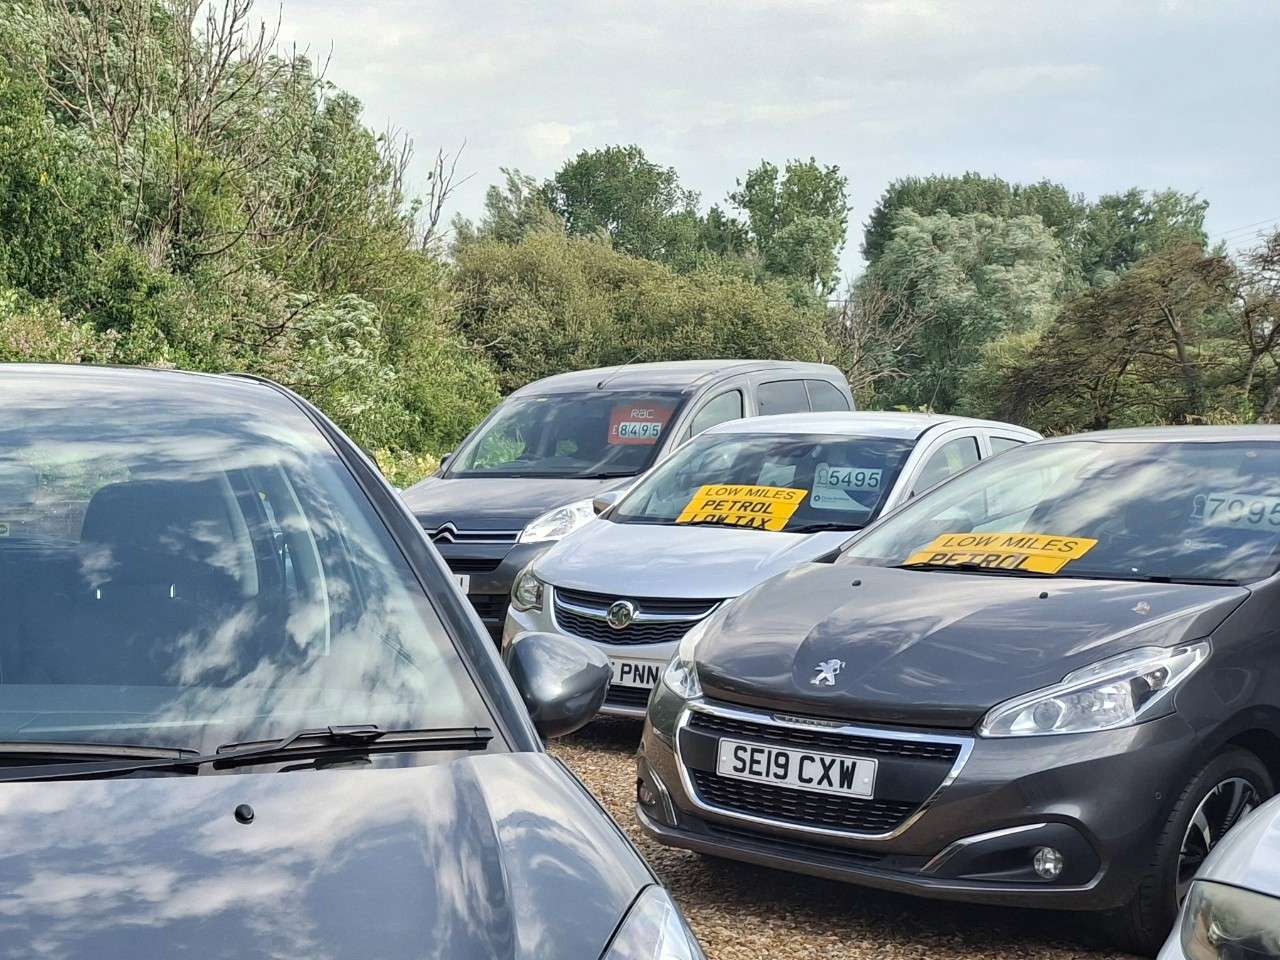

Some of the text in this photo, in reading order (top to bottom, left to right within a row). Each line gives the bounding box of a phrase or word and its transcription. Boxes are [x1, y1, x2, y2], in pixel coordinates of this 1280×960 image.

[705, 487, 797, 500] LOW MILES
[700, 500, 774, 514] PETROL
[733, 515, 773, 530] TAX
[942, 535, 1078, 553] LOW MILES
[927, 552, 1030, 570] PETROL
[620, 663, 660, 685] PNN
[732, 745, 857, 790] SE19 CXW
